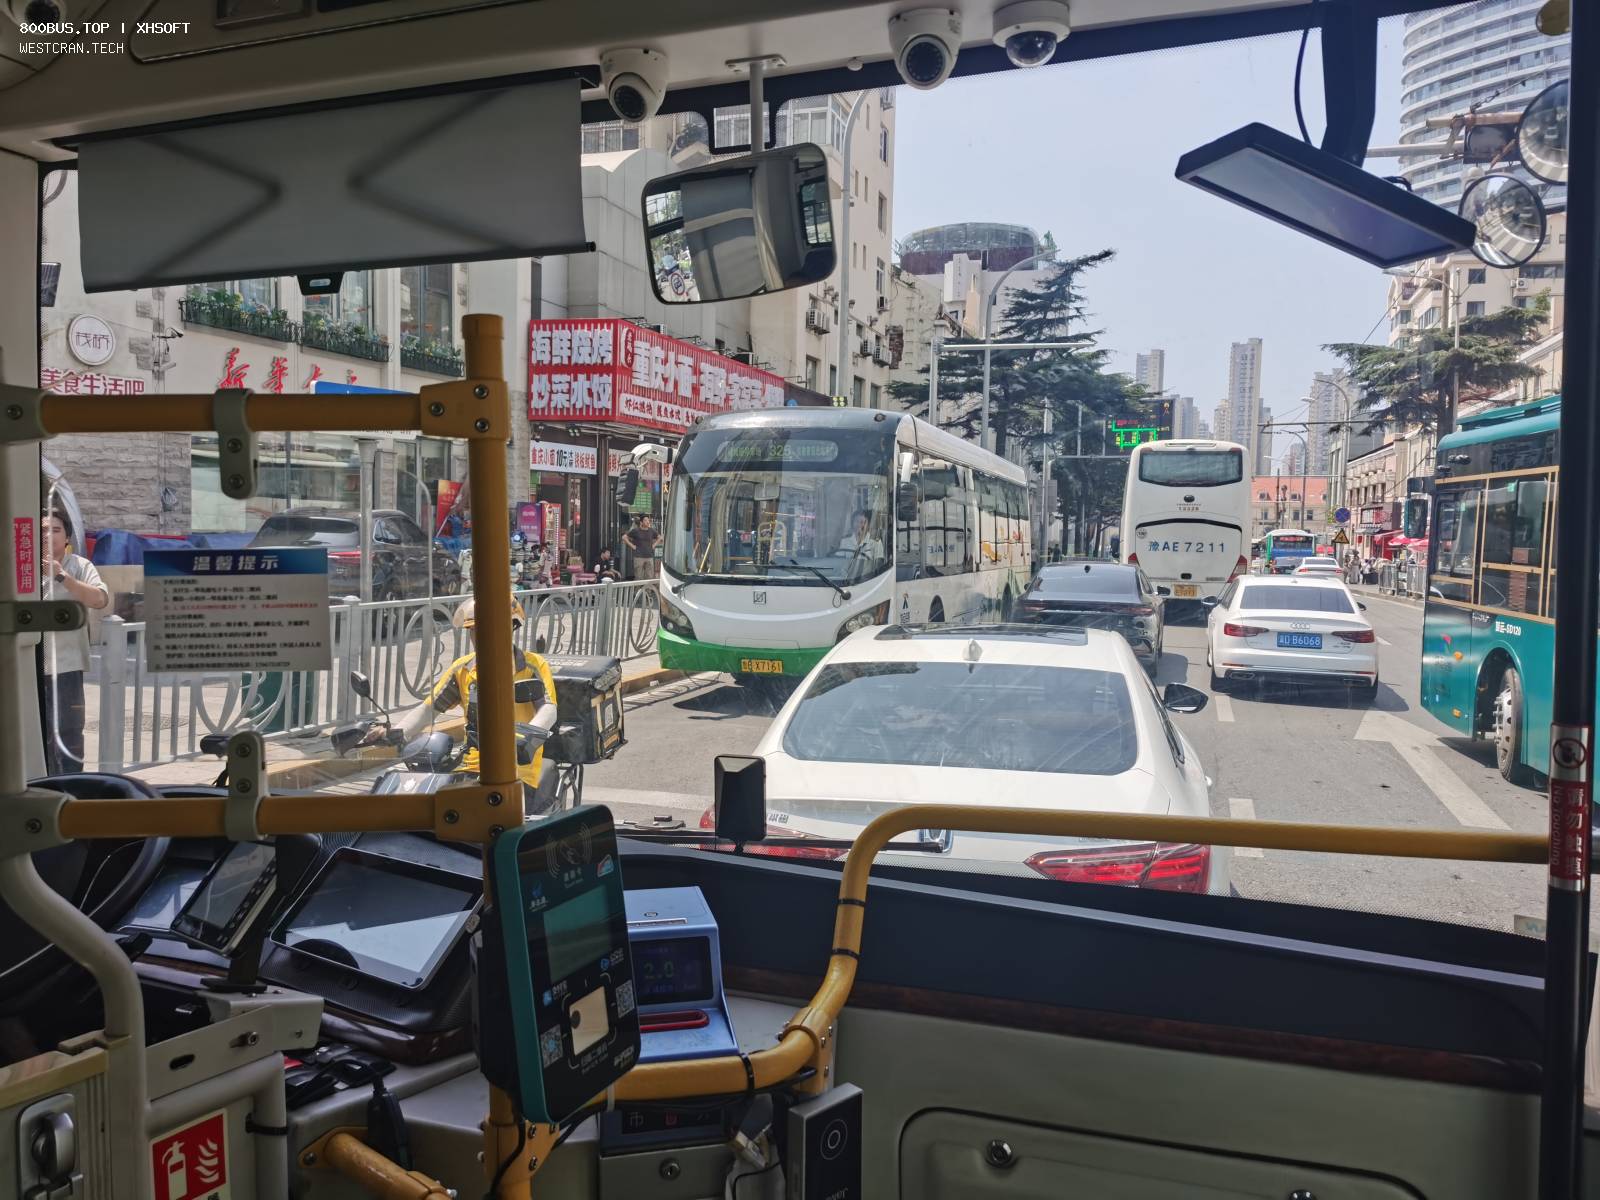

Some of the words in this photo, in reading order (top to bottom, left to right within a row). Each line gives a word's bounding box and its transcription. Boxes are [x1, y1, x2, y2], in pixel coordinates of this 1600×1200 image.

[531, 328, 613, 366] 海鲜烧烤
[41, 367, 144, 395] 美食生活吧
[531, 373, 613, 411] 炒菜水饺
[192, 554, 279, 571] 温馨提示
